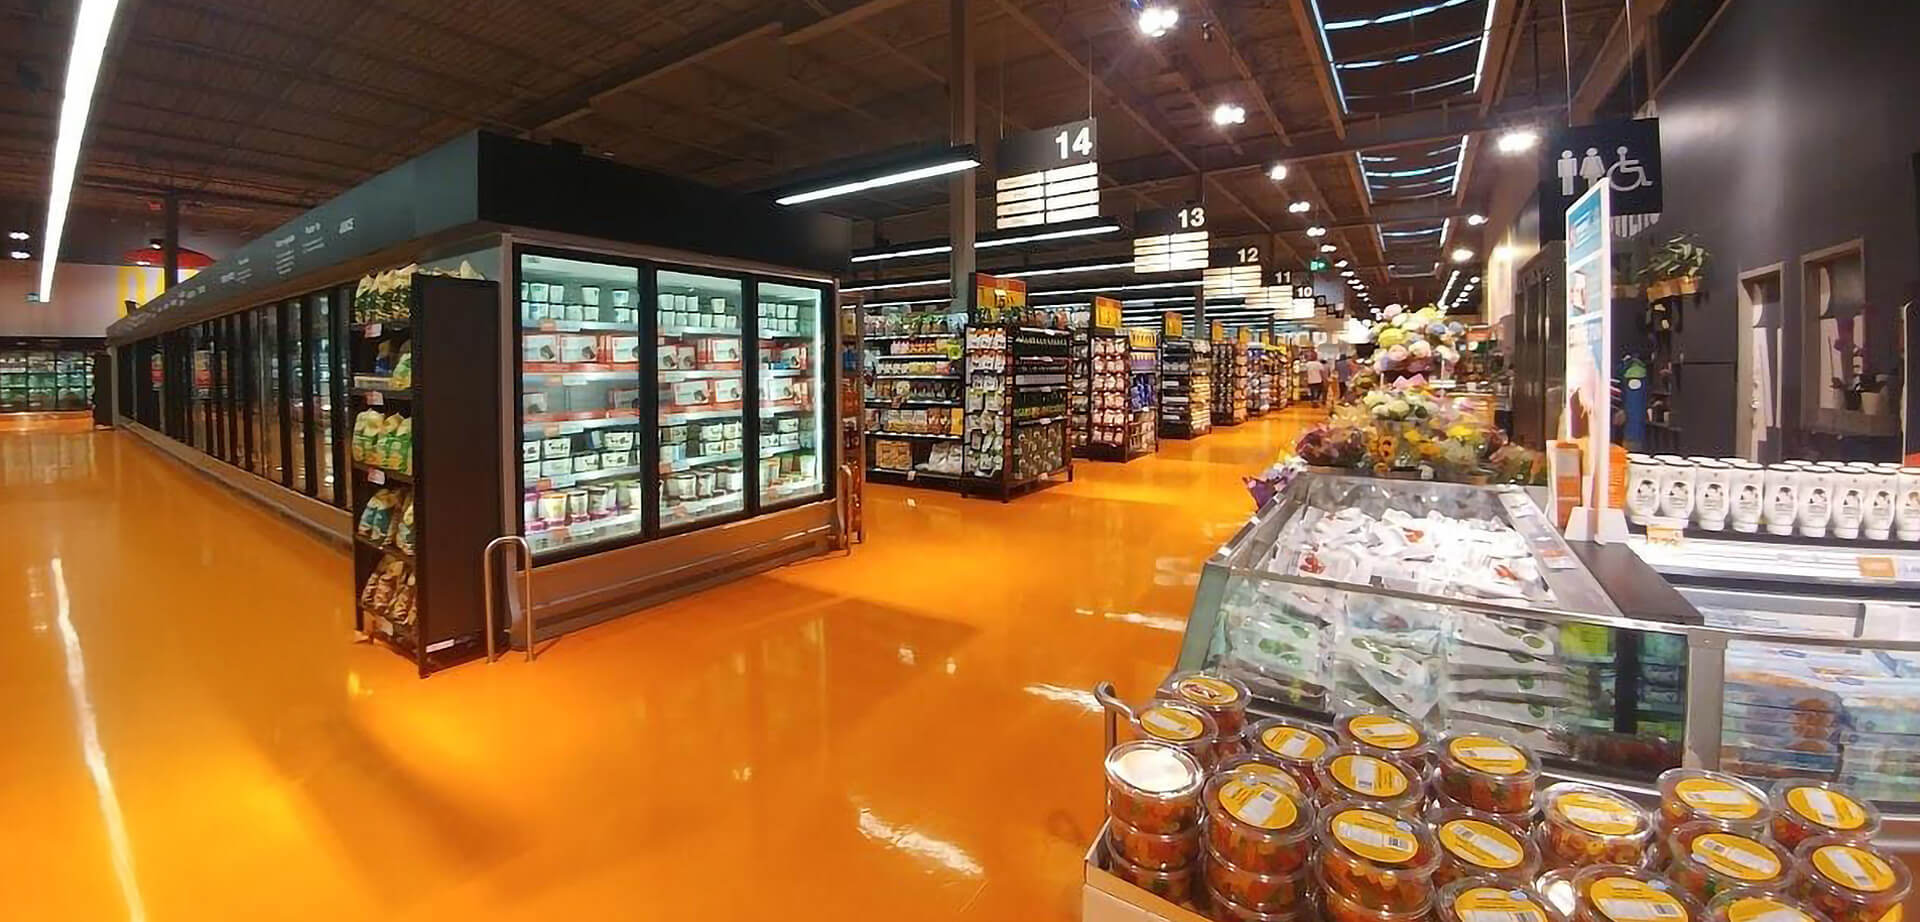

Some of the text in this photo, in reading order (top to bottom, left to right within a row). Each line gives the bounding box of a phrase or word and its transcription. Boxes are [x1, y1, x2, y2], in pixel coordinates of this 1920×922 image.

[1055, 126, 1093, 160] 14
[1177, 207, 1205, 229] 13
[1237, 247, 1260, 264] 12
[1275, 271, 1291, 284] 11
[1296, 286, 1313, 298] 10
